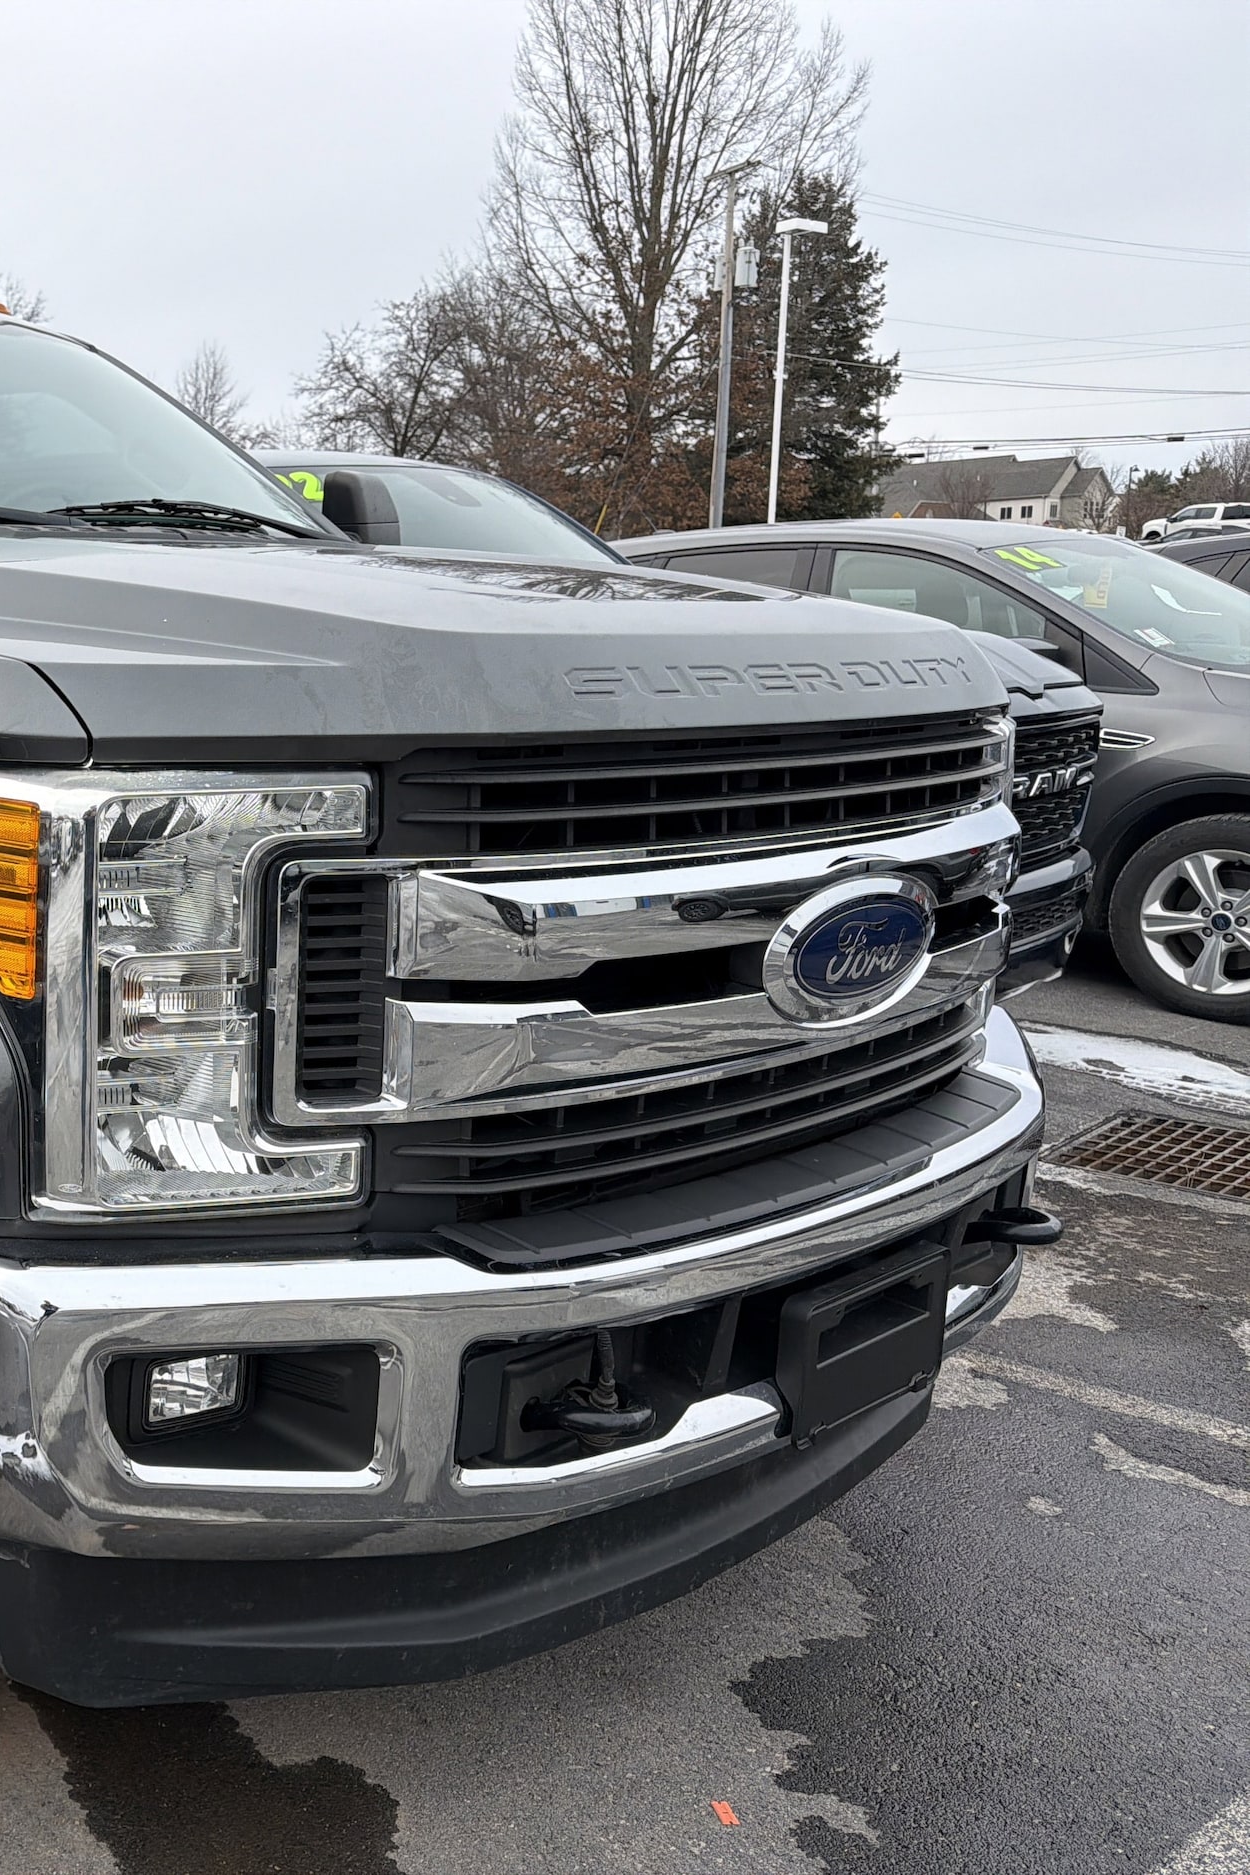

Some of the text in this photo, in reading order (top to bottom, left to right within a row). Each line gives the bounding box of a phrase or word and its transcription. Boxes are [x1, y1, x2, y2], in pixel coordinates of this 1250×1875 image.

[994, 546, 1064, 570] 14
[563, 656, 973, 699] SUPER DUTY
[825, 917, 907, 985] Ford
